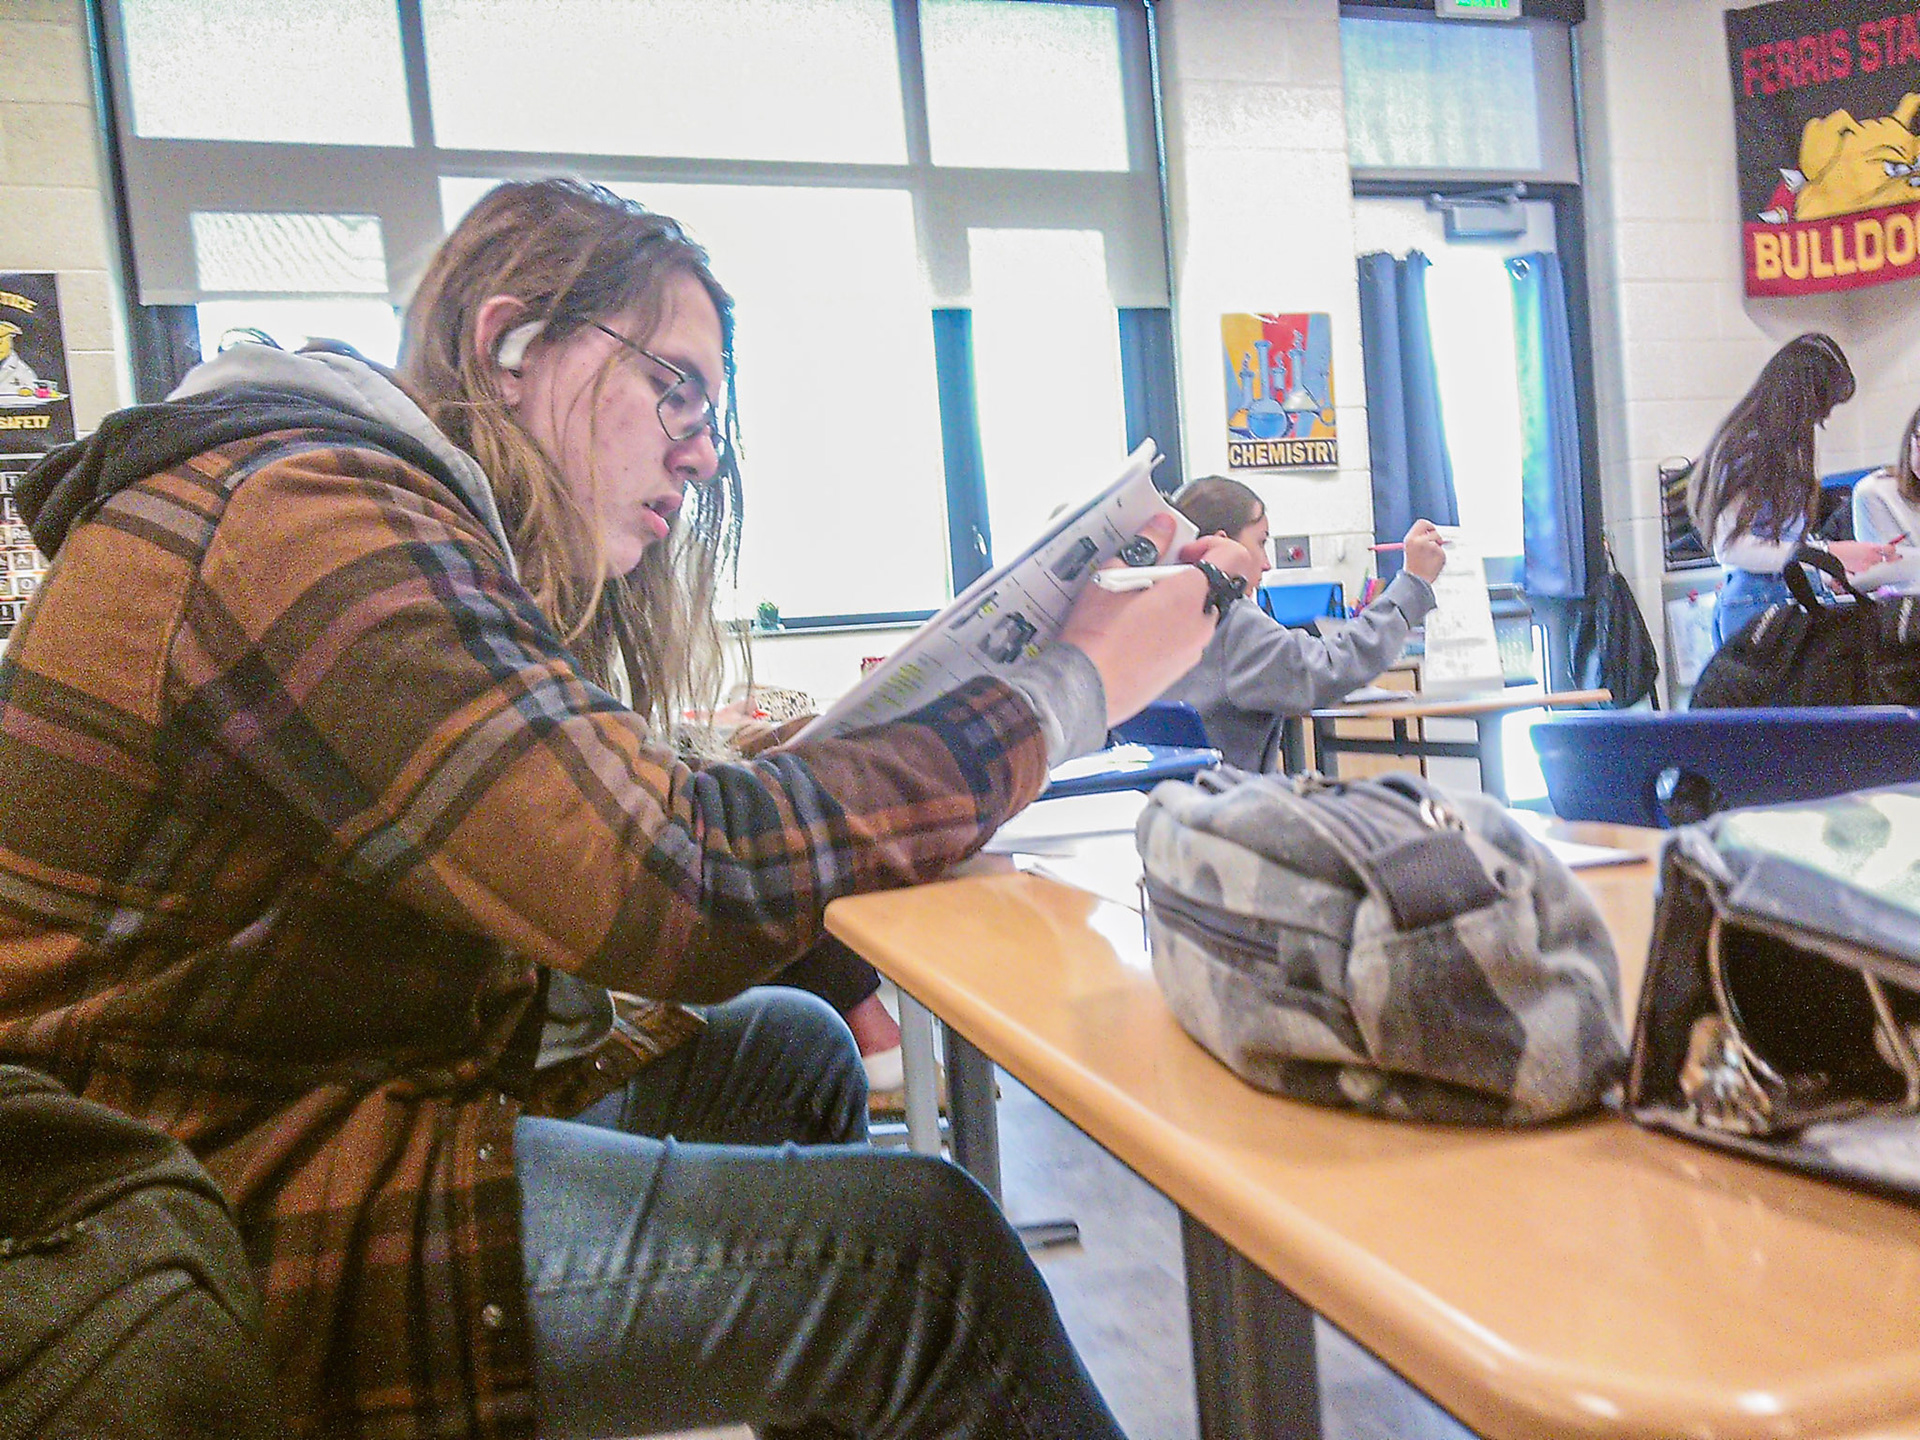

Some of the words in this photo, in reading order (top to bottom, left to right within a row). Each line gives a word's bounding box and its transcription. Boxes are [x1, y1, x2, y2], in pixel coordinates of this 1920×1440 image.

[1743, 28, 1852, 96] FERRIS
[1858, 10, 1920, 73] STA
[1753, 209, 1920, 281] BULLDO
[1229, 441, 1337, 467] CHEMISTRY
